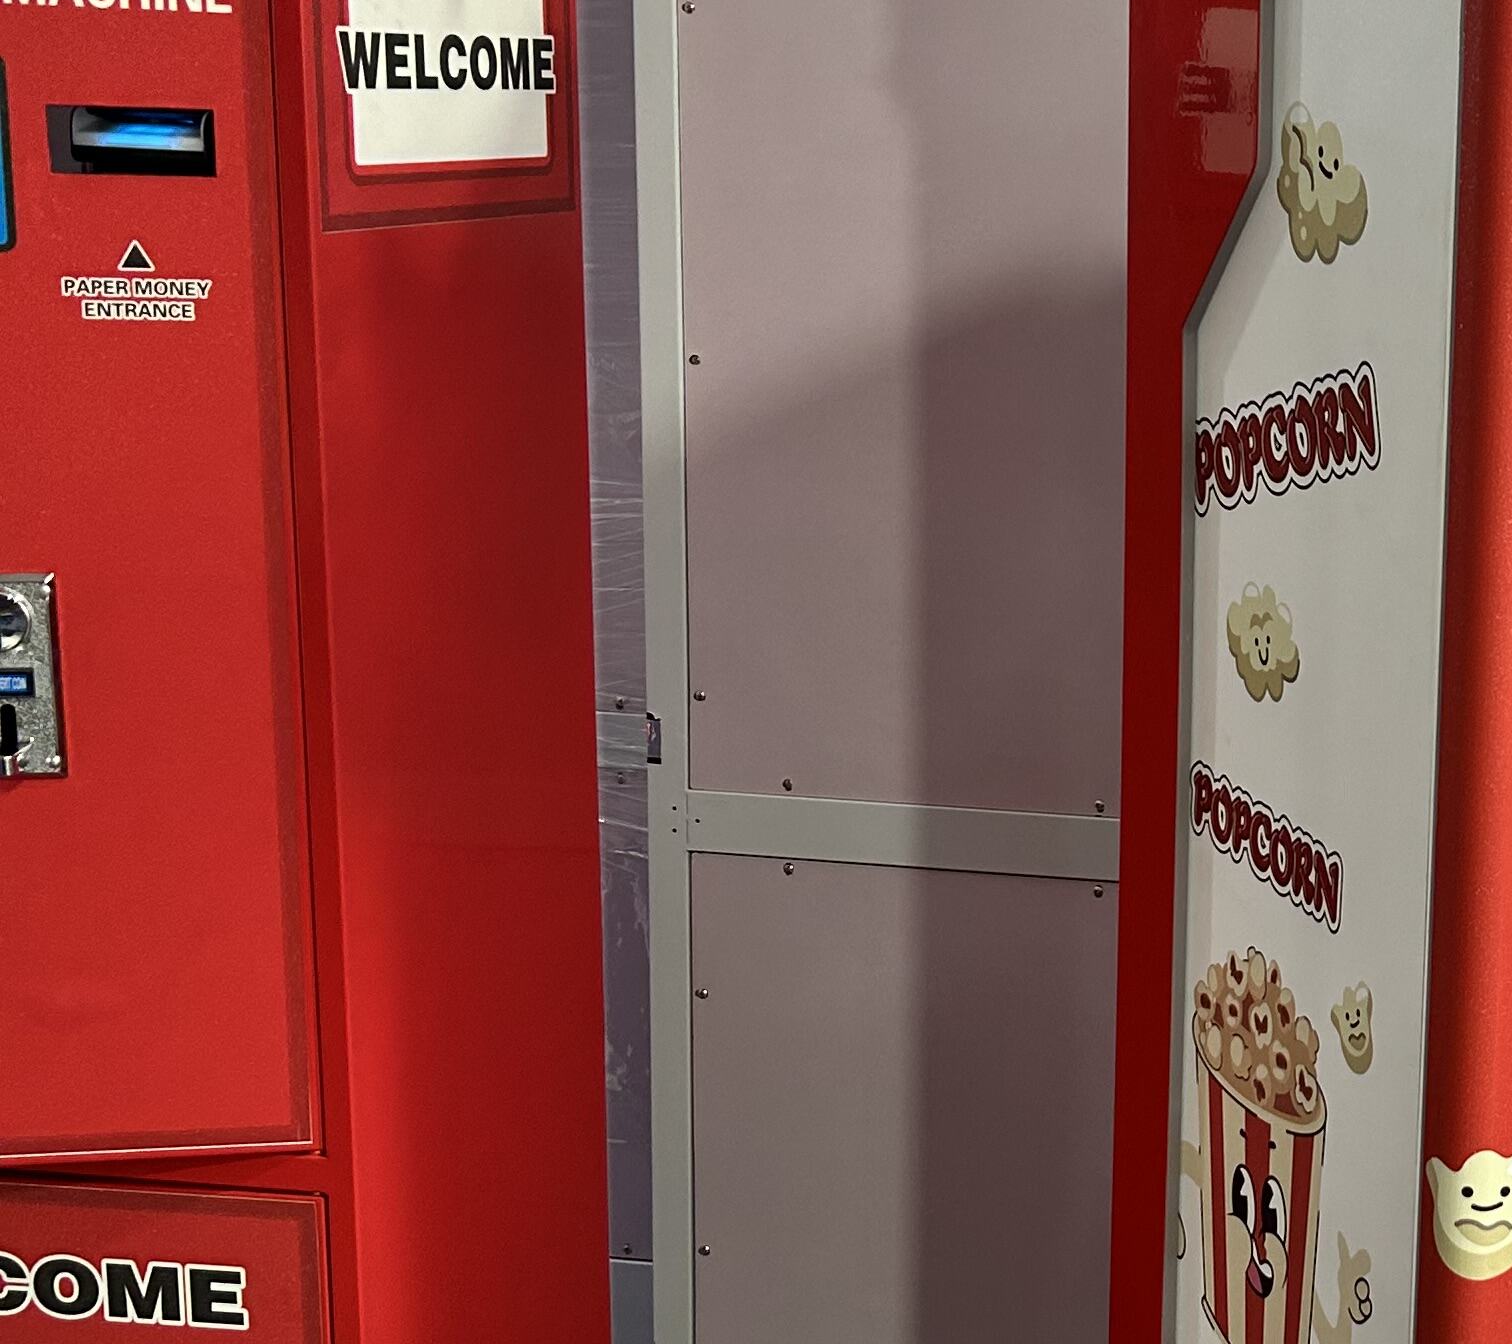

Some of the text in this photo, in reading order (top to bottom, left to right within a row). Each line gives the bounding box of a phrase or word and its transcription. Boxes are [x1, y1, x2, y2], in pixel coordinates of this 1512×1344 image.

[337, 29, 555, 92] WELCOME
[62, 279, 210, 297] PAPER MONEY
[84, 301, 193, 319] ENTRANCE
[1194, 367, 1379, 512] POPCORN
[1191, 764, 1342, 929] POPCORN
